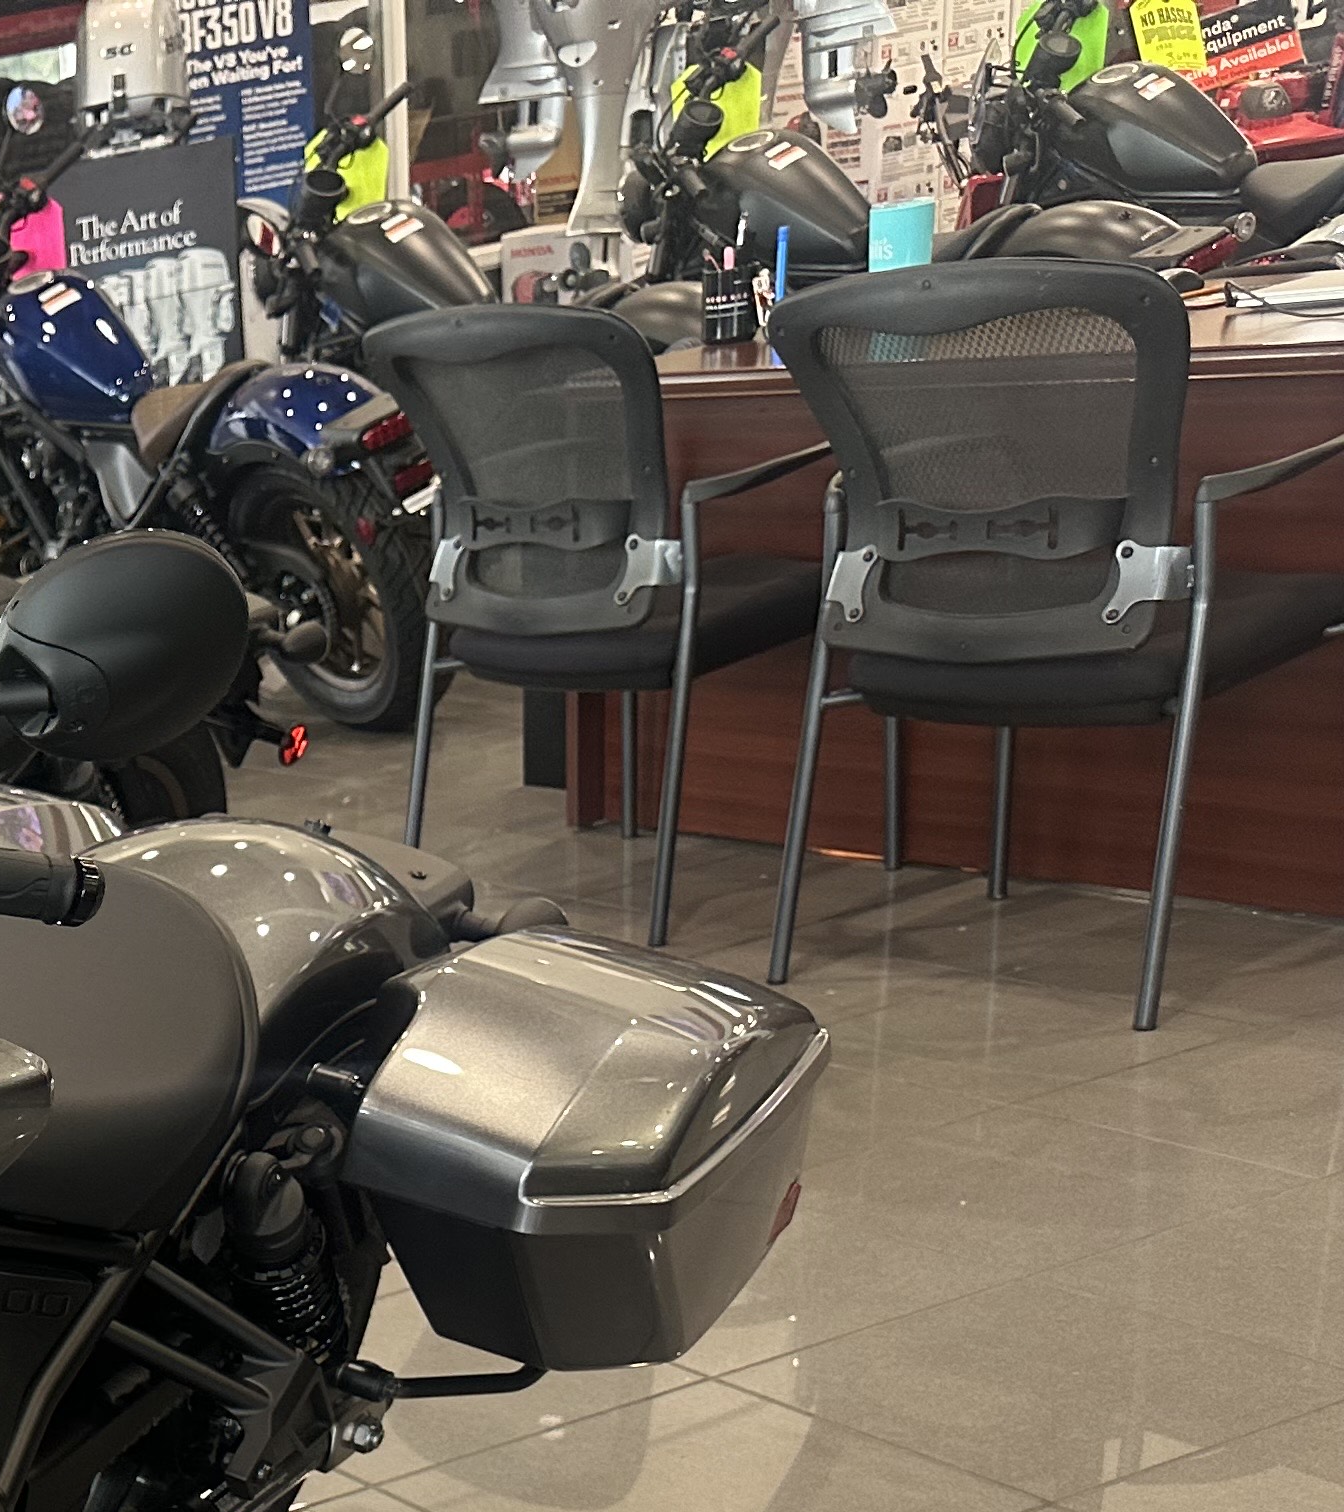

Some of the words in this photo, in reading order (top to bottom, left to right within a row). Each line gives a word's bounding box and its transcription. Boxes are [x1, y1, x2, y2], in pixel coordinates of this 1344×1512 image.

[257, 0, 293, 40] V8
[1140, 11, 1155, 27] NO
[1203, 15, 1287, 54] quipment
[1219, 34, 1295, 71] Available!
[211, 64, 271, 87] Waiting
[75, 212, 119, 241] The
[119, 207, 159, 236] Art
[160, 197, 184, 228] of
[69, 229, 198, 268] Performance
